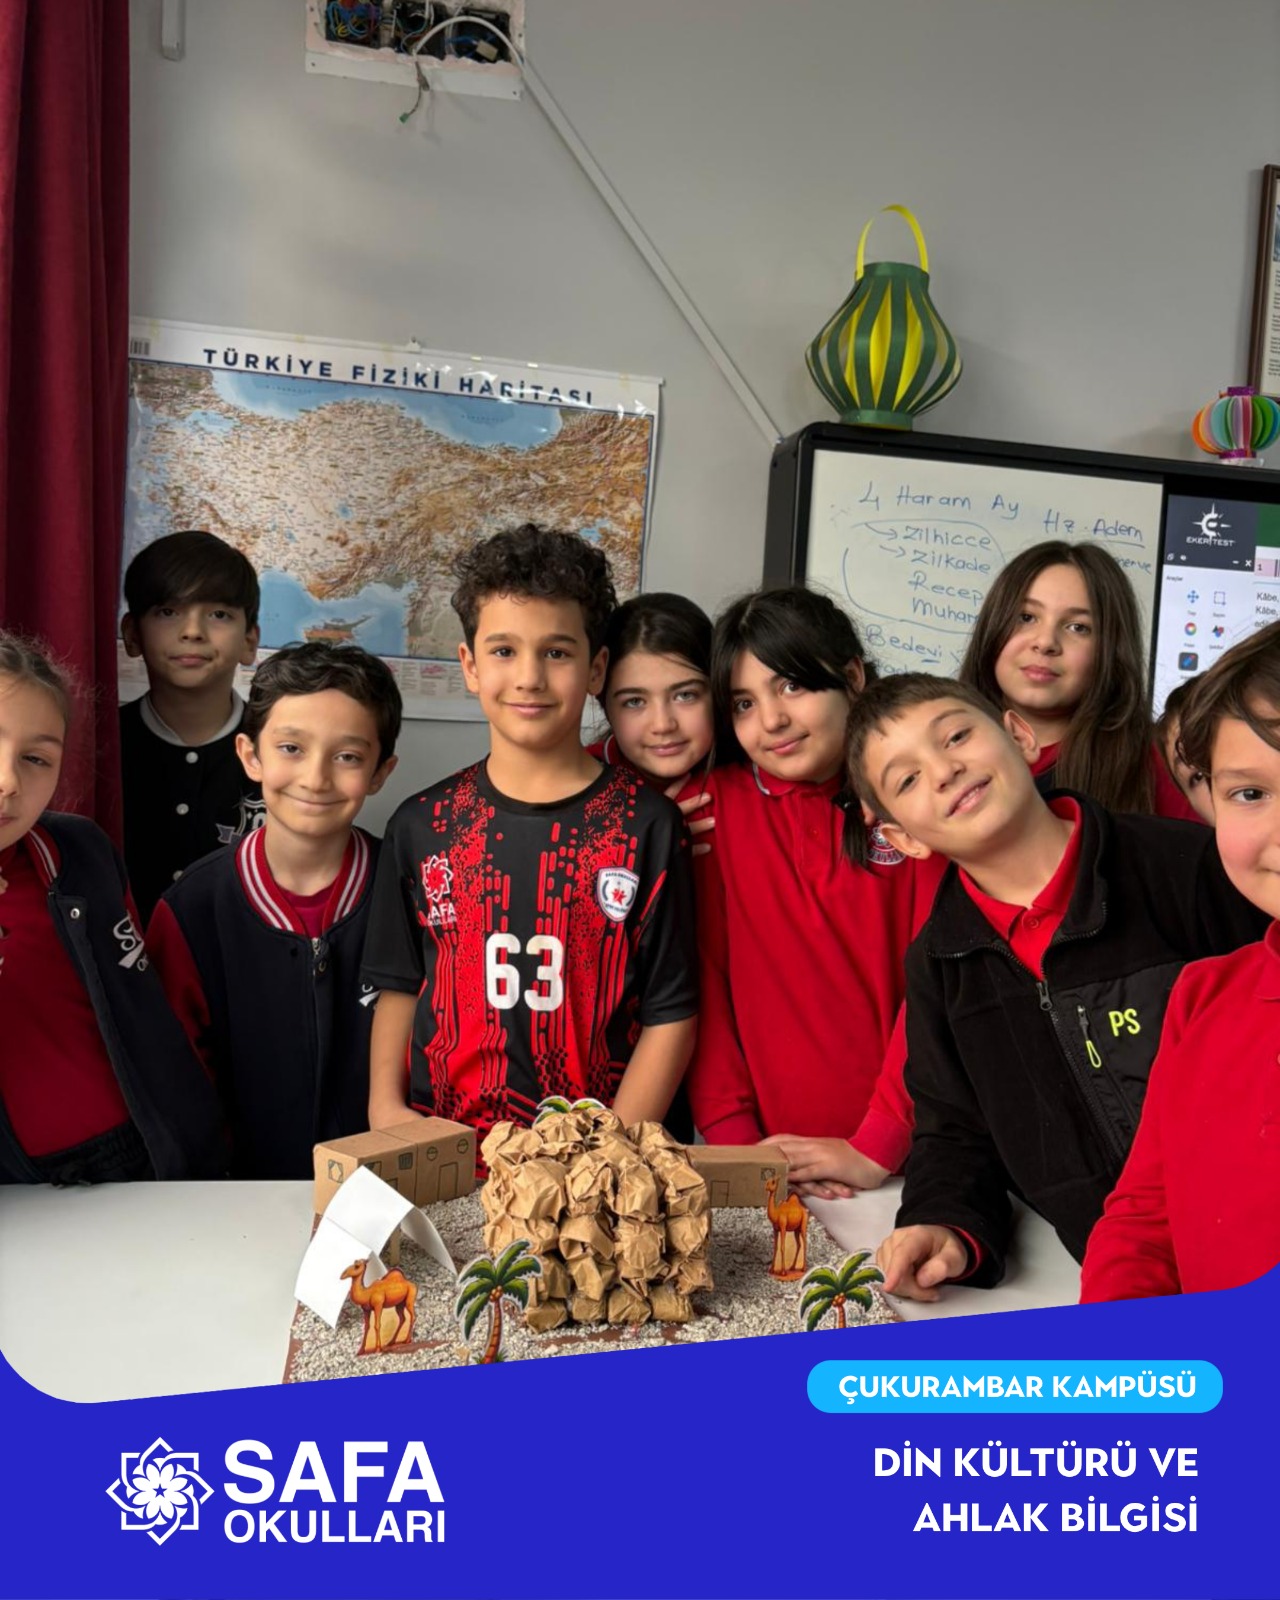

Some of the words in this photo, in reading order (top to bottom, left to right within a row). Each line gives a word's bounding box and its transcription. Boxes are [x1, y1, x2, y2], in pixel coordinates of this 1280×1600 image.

[203, 348, 333, 377] TÜRKİYE
[351, 362, 440, 389] FİZİKİ
[459, 377, 592, 404] HARİTASI
[859, 480, 880, 511] 4
[896, 485, 971, 510] Haram
[991, 494, 1019, 520] Ay
[1093, 518, 1143, 541] Adem
[908, 570, 984, 607] Recep
[865, 624, 943, 657] Bedevi
[486, 934, 564, 1011] 63
[1109, 1008, 1141, 1037] PS
